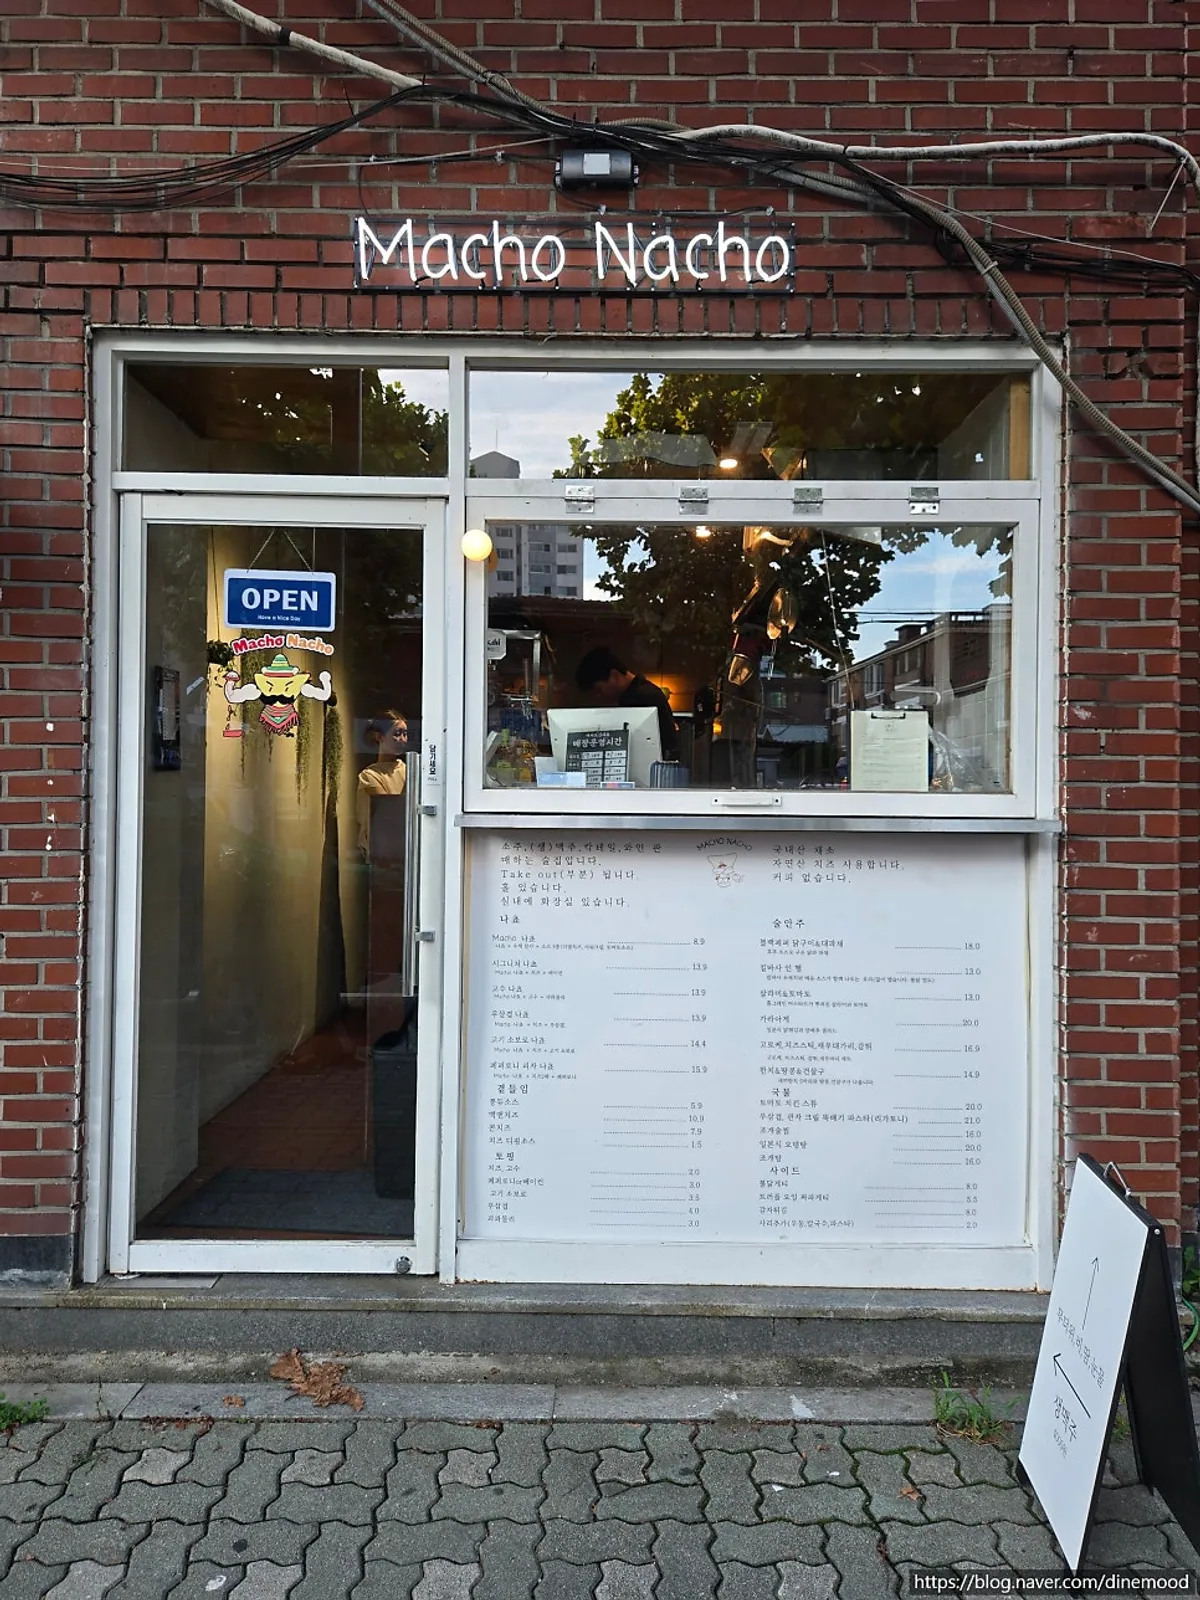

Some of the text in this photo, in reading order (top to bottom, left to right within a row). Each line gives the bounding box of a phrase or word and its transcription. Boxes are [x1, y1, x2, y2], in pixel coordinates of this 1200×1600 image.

[357, 217, 790, 287] Macho Nacho
[241, 588, 318, 611] OPEN
[232, 633, 334, 655] Macho Nacho
[814, 859, 835, 869] 치즈
[843, 859, 904, 870] 사용합니다.
[500, 869, 531, 880] Take
[772, 873, 852, 884] 커피 없습니다.
[518, 883, 567, 893] 있습니다.
[581, 896, 630, 908] 있습니다.
[690, 1102, 703, 1110] 5.9
[688, 1115, 704, 1123] 10.9
[691, 1141, 702, 1149] 1.5
[965, 1144, 982, 1152] 20.0
[689, 1181, 701, 1189] 3.0
[688, 1220, 700, 1228] 3.0
